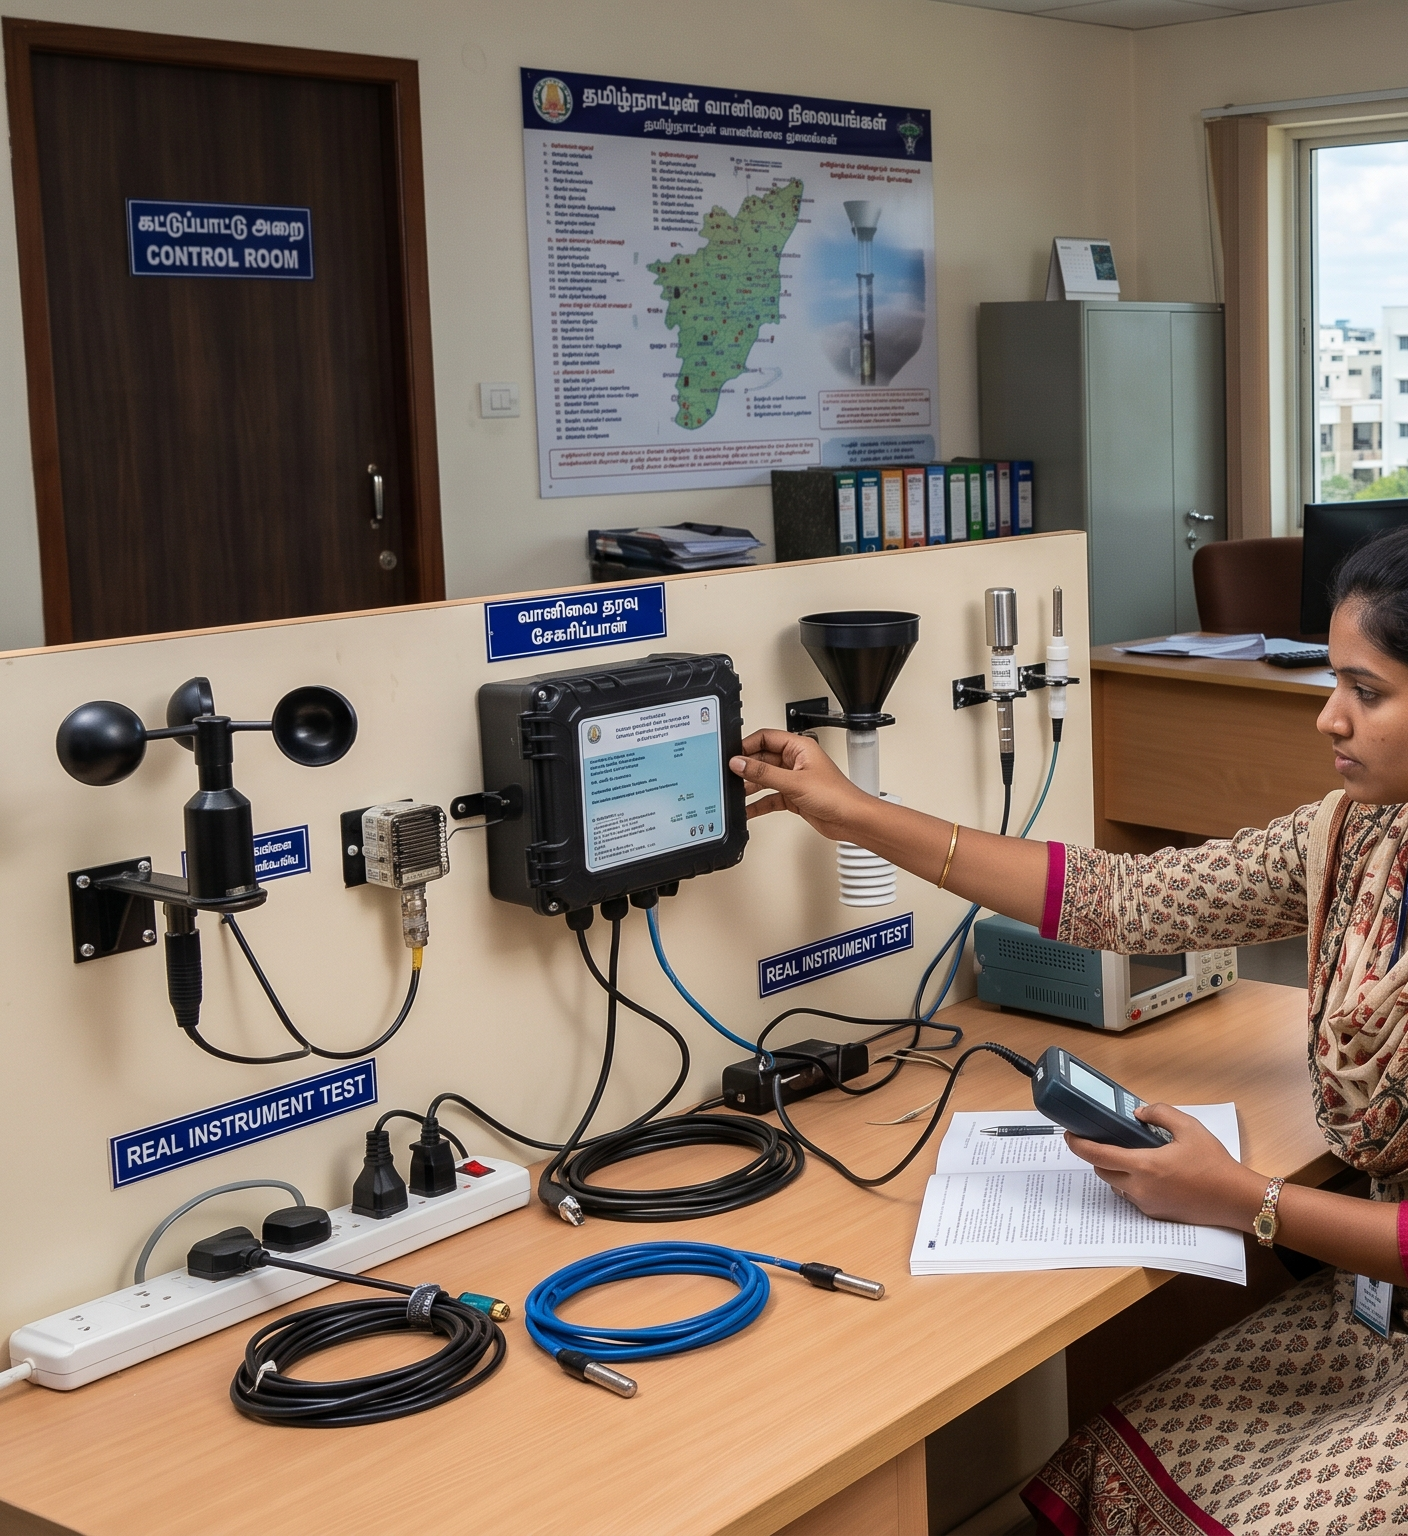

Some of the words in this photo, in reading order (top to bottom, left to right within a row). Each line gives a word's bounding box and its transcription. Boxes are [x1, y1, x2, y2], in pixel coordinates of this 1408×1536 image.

[582, 85, 700, 115] தமிழ்நாட்டின்
[704, 98, 784, 121] வானிலை
[788, 104, 887, 131] நிலையங்கள்
[138, 210, 248, 240] கட்டுப்பாட்டு
[251, 218, 305, 242] அறை
[146, 244, 239, 268] CONTROL
[244, 248, 299, 269] ROOM
[602, 596, 639, 618] தரவு
[531, 616, 628, 645] சேகரிப்பான்
[766, 960, 800, 984] REAL
[802, 933, 878, 972] INSTRUMENT
[879, 923, 909, 946] TEST
[126, 1133, 184, 1169] REAL
[188, 1090, 315, 1149] INSTRUMENT
[319, 1074, 366, 1106] TEST
